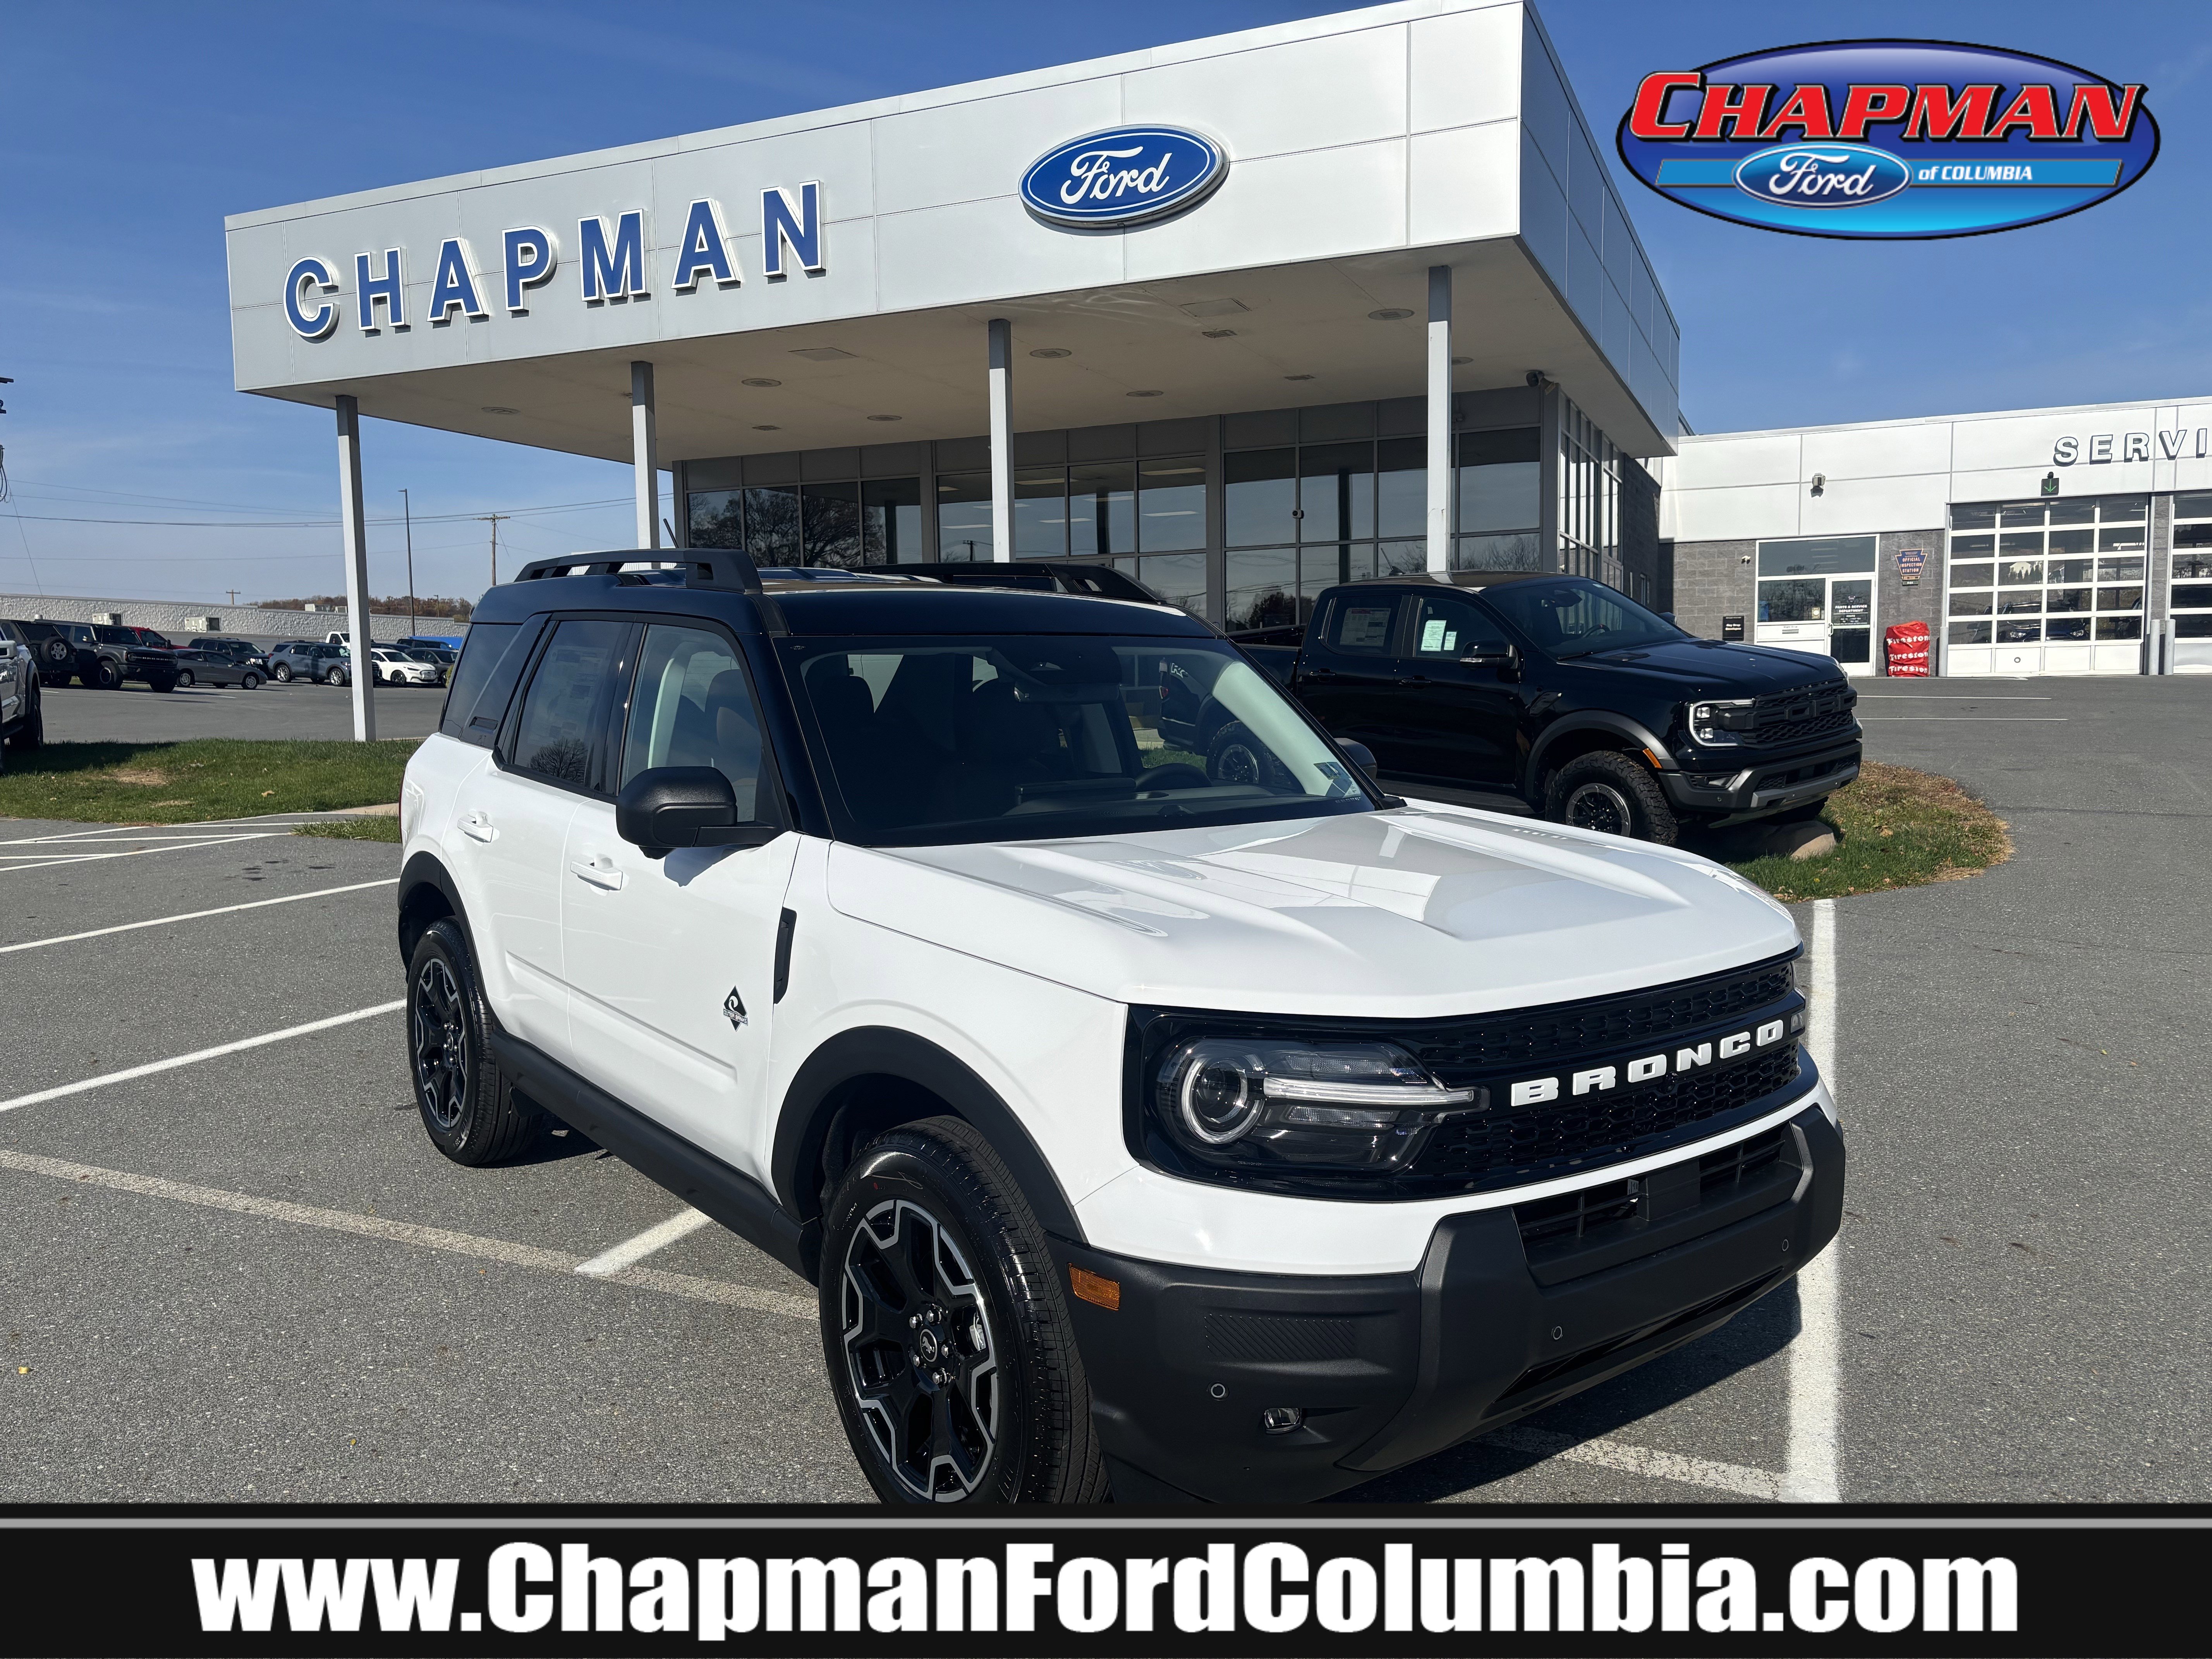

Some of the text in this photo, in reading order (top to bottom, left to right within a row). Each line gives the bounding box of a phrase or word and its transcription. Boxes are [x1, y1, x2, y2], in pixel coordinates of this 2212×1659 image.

[1060, 146, 1172, 204] Ford
[283, 180, 825, 338] CHAPMAN
[2053, 428, 2207, 467] SERVI
[724, 1010, 747, 1024] OUTER BANKS
[1511, 1020, 1783, 1106] BRONCO
